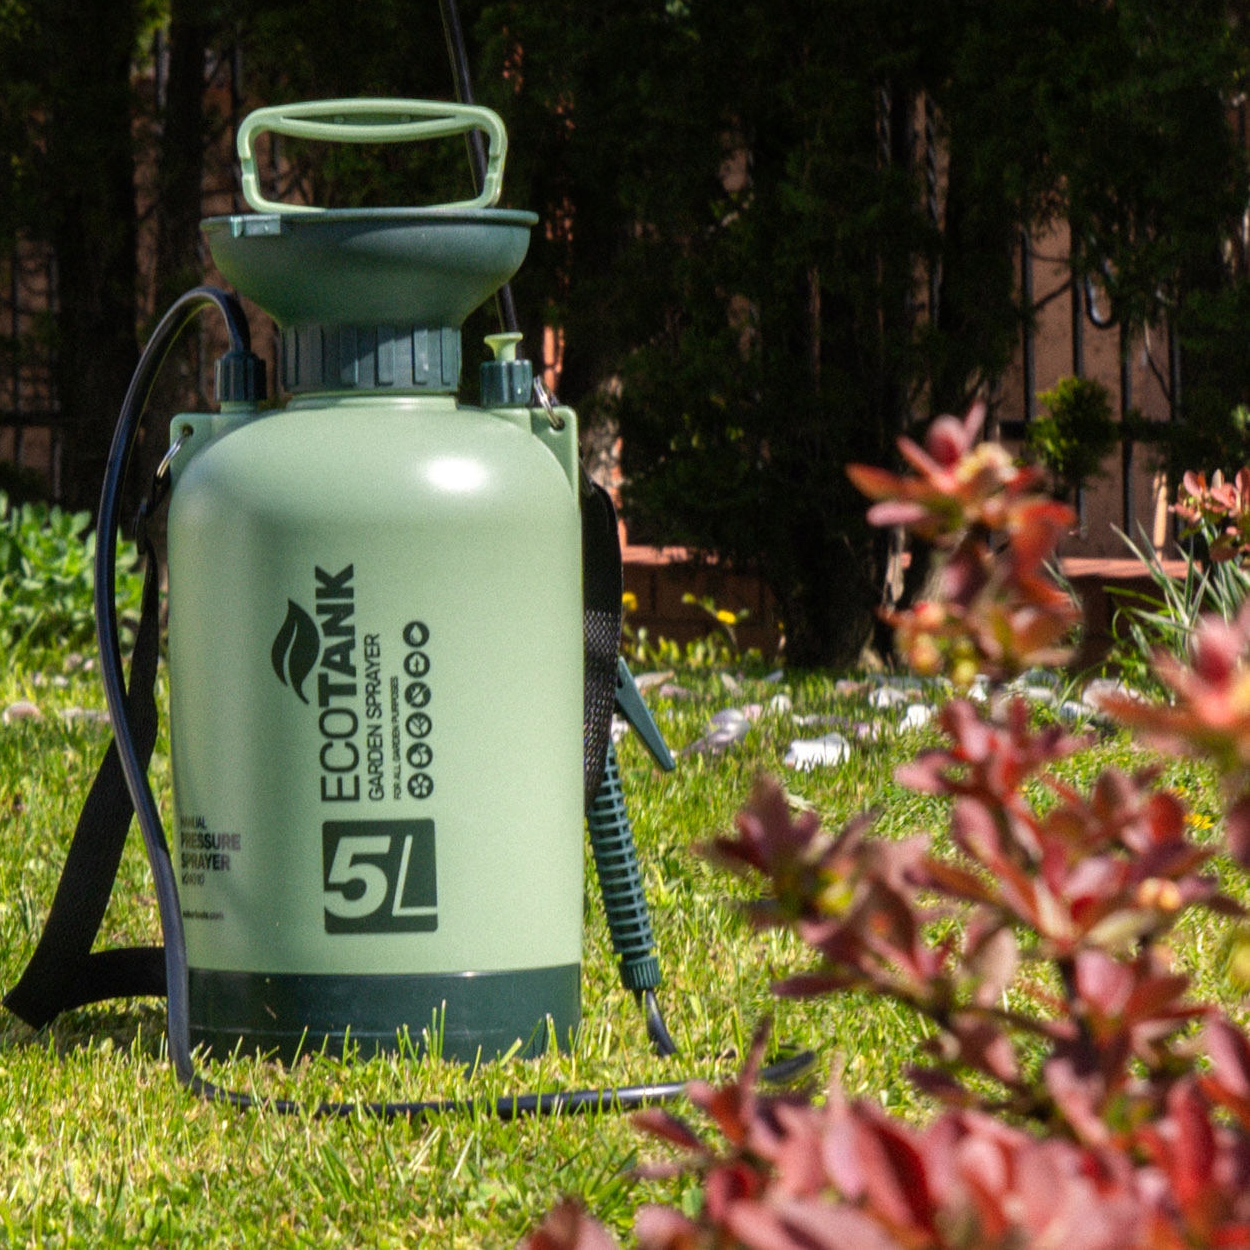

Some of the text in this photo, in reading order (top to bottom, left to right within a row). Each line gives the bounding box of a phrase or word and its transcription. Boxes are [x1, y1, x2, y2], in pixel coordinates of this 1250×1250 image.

[315, 563, 361, 802] ECOTANK
[364, 633, 384, 801] GARDEN SPRAYER
[323, 834, 438, 919] 5L
